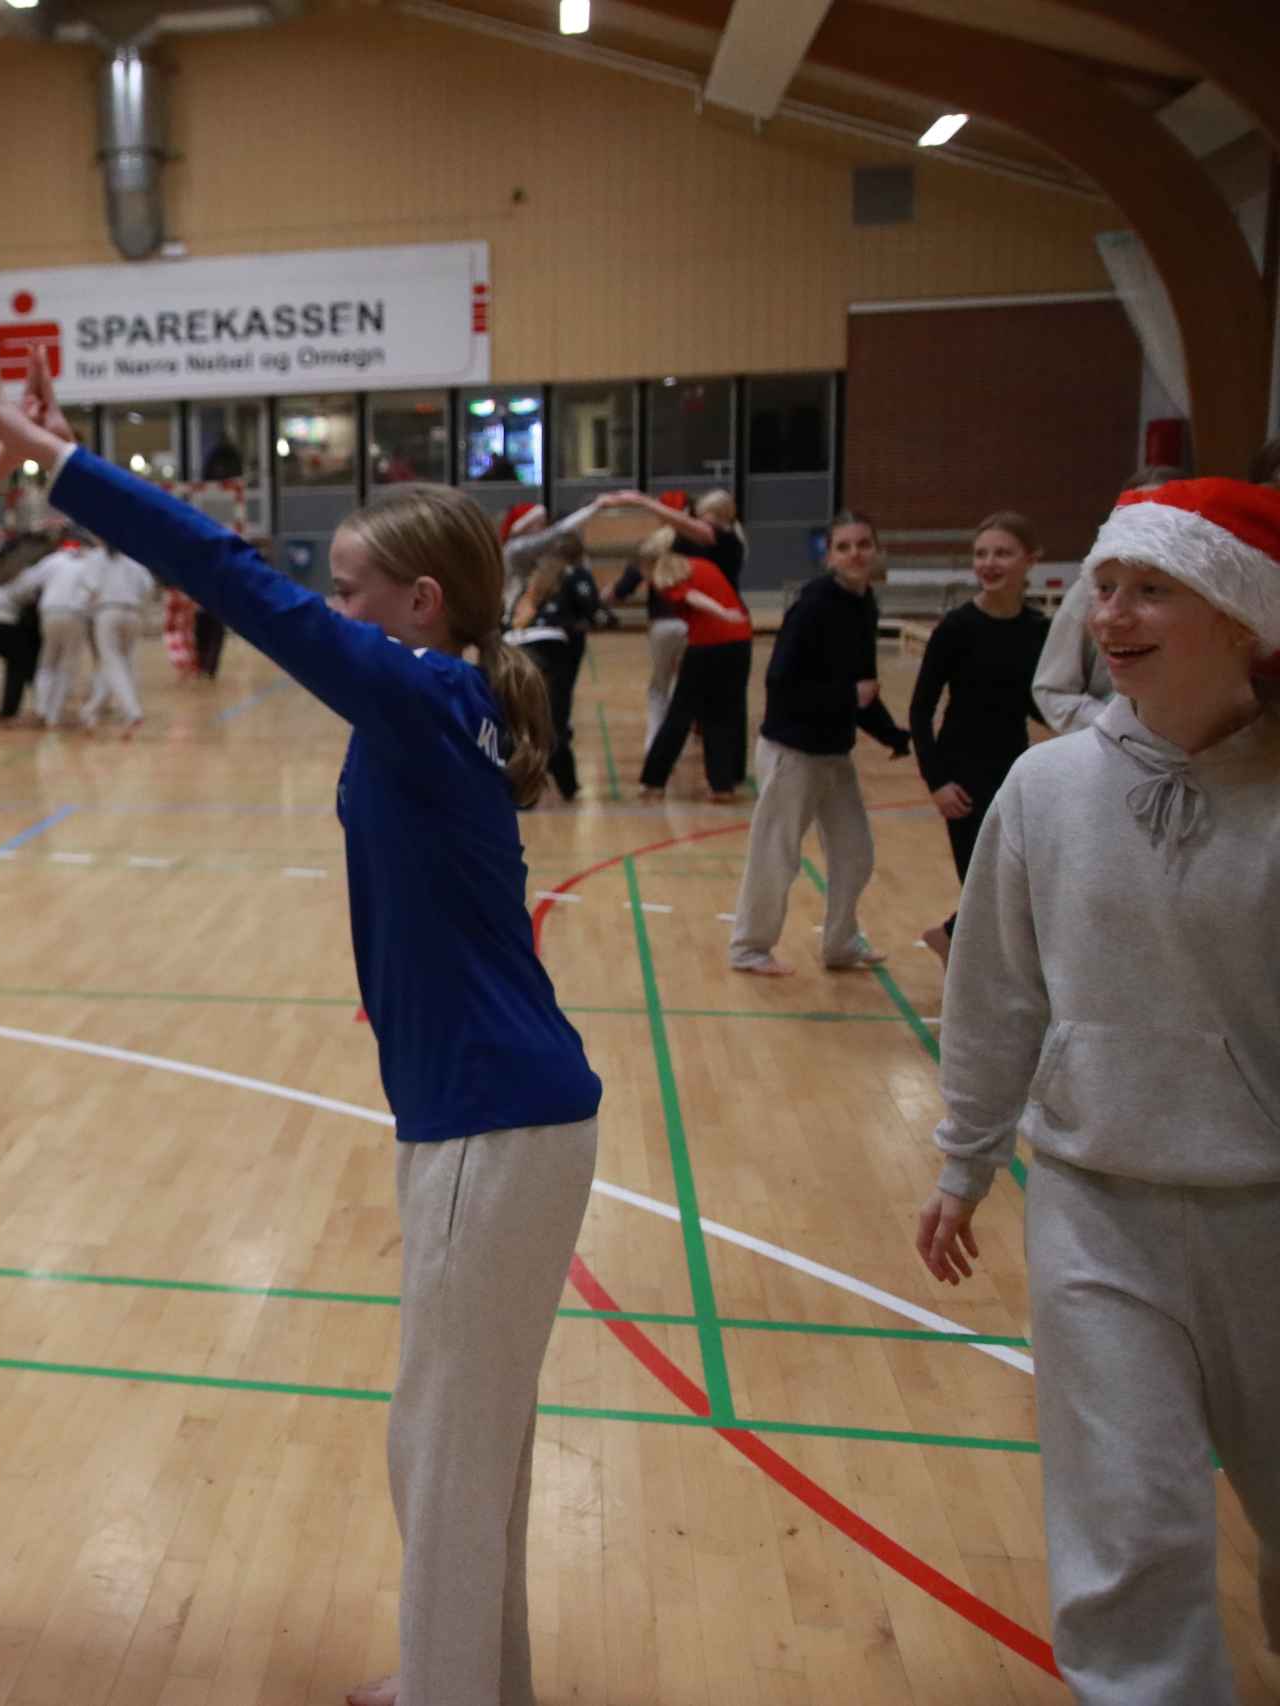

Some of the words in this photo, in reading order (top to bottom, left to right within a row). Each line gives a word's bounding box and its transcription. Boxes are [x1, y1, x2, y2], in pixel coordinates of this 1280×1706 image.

[77, 299, 385, 350] SPAREKASSEN
[77, 361, 105, 379] for
[187, 352, 252, 371] Nebel
[260, 351, 290, 371] og
[298, 345, 385, 371] Omegn
